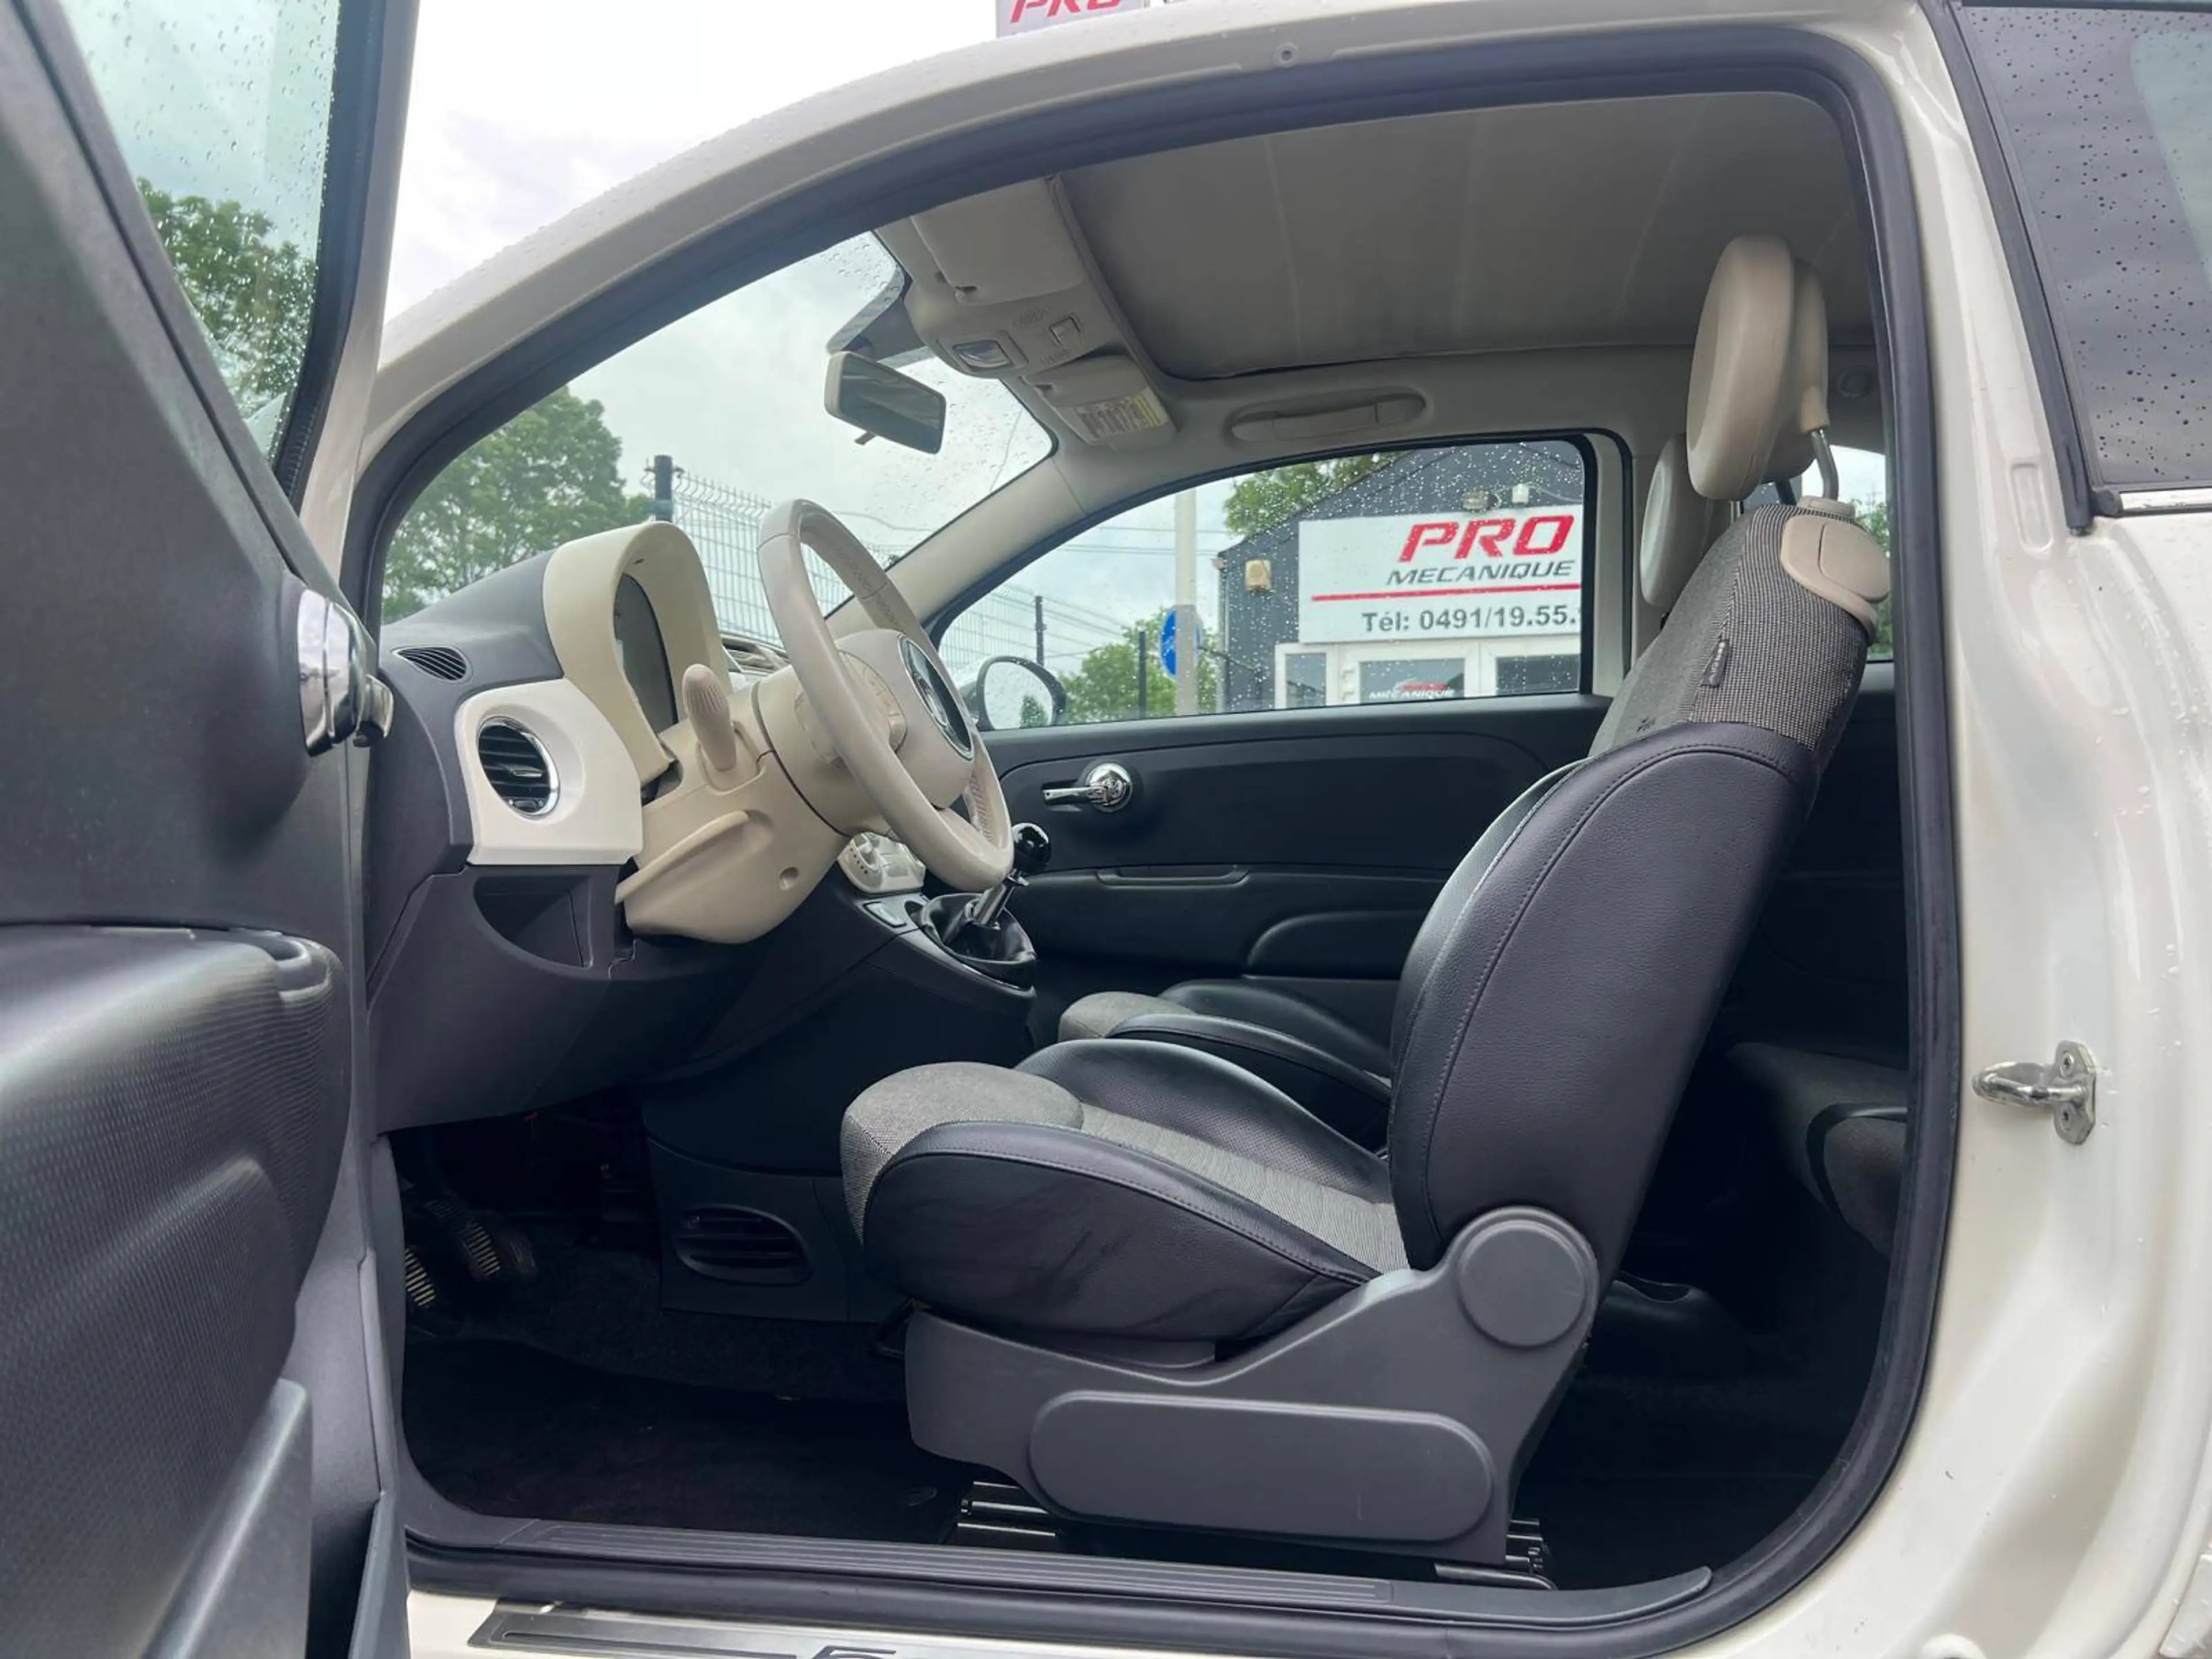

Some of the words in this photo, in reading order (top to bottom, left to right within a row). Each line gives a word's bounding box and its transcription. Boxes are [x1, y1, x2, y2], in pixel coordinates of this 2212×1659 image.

[1398, 514, 1575, 563] PRO
[1386, 560, 1575, 586] MECANIQUE
[1362, 611, 1410, 631] Tél:
[1419, 605, 1581, 630] 0491/19.55.
